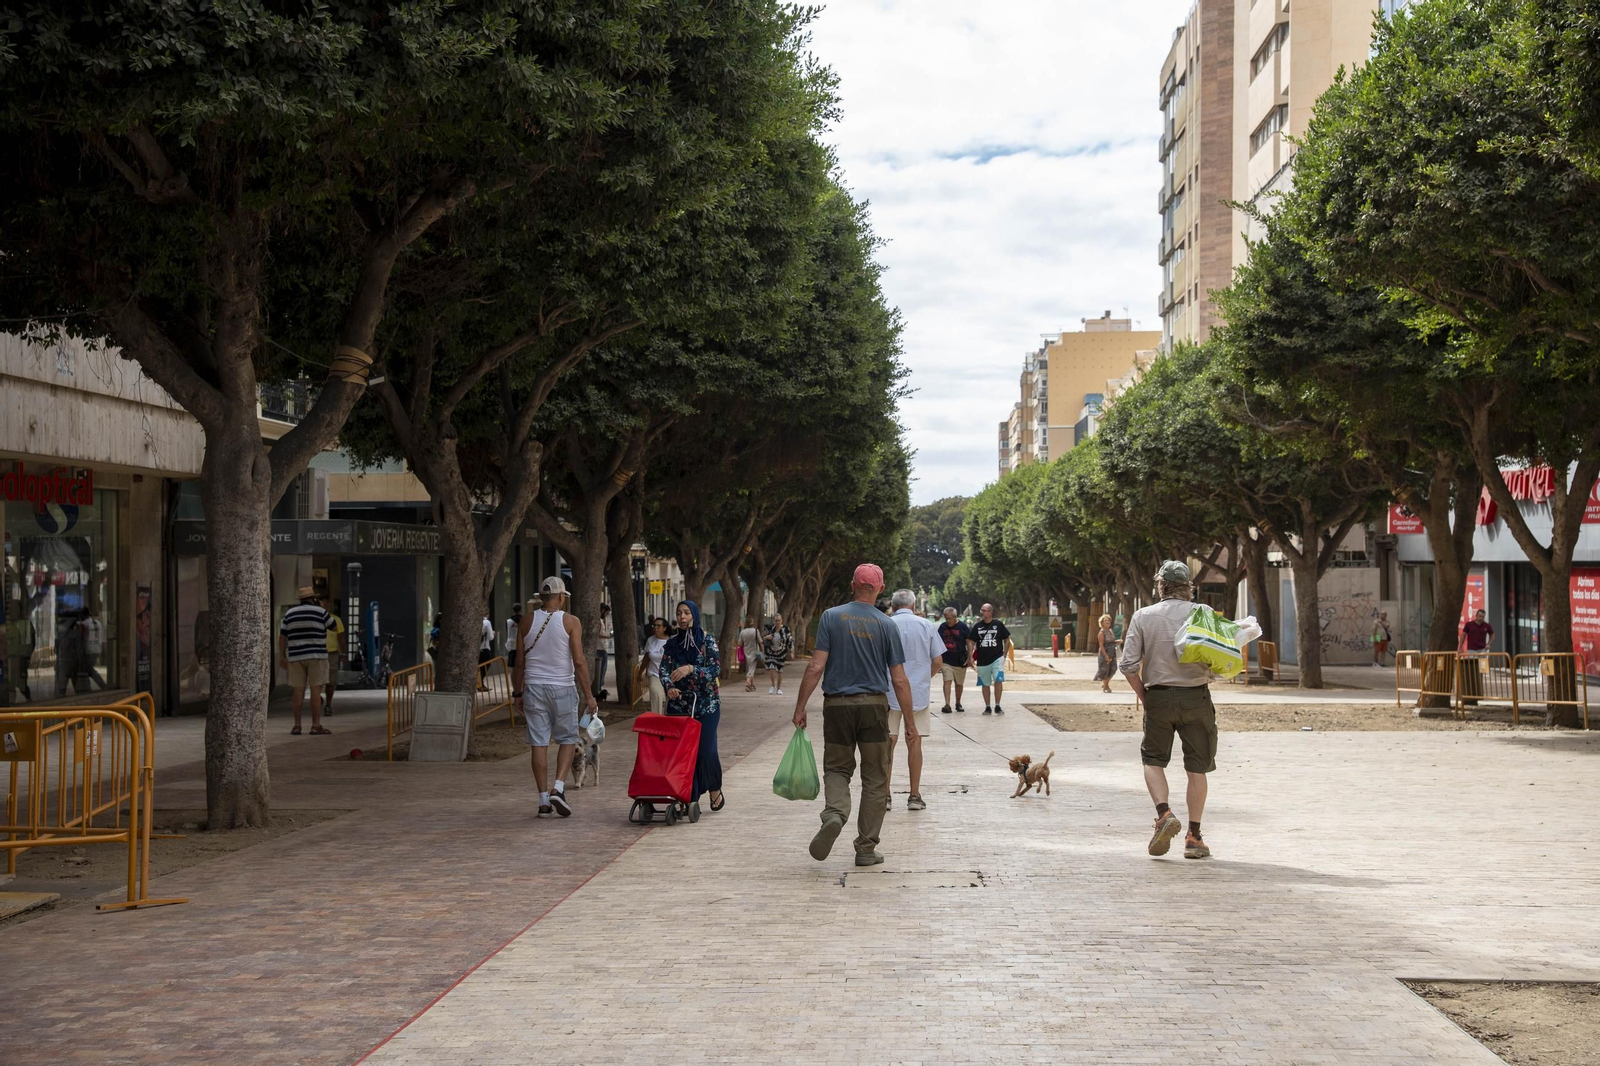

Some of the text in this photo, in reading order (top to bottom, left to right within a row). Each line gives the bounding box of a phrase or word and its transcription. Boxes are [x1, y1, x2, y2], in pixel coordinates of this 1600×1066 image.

[0, 462, 93, 514] oloptical
[1502, 465, 1555, 504] market
[185, 533, 207, 542] JOY
[307, 532, 350, 540] REGENTE
[405, 530, 439, 551] REGENTE
[1577, 576, 1595, 587] Abrimos
[1573, 588, 1584, 599] todos
